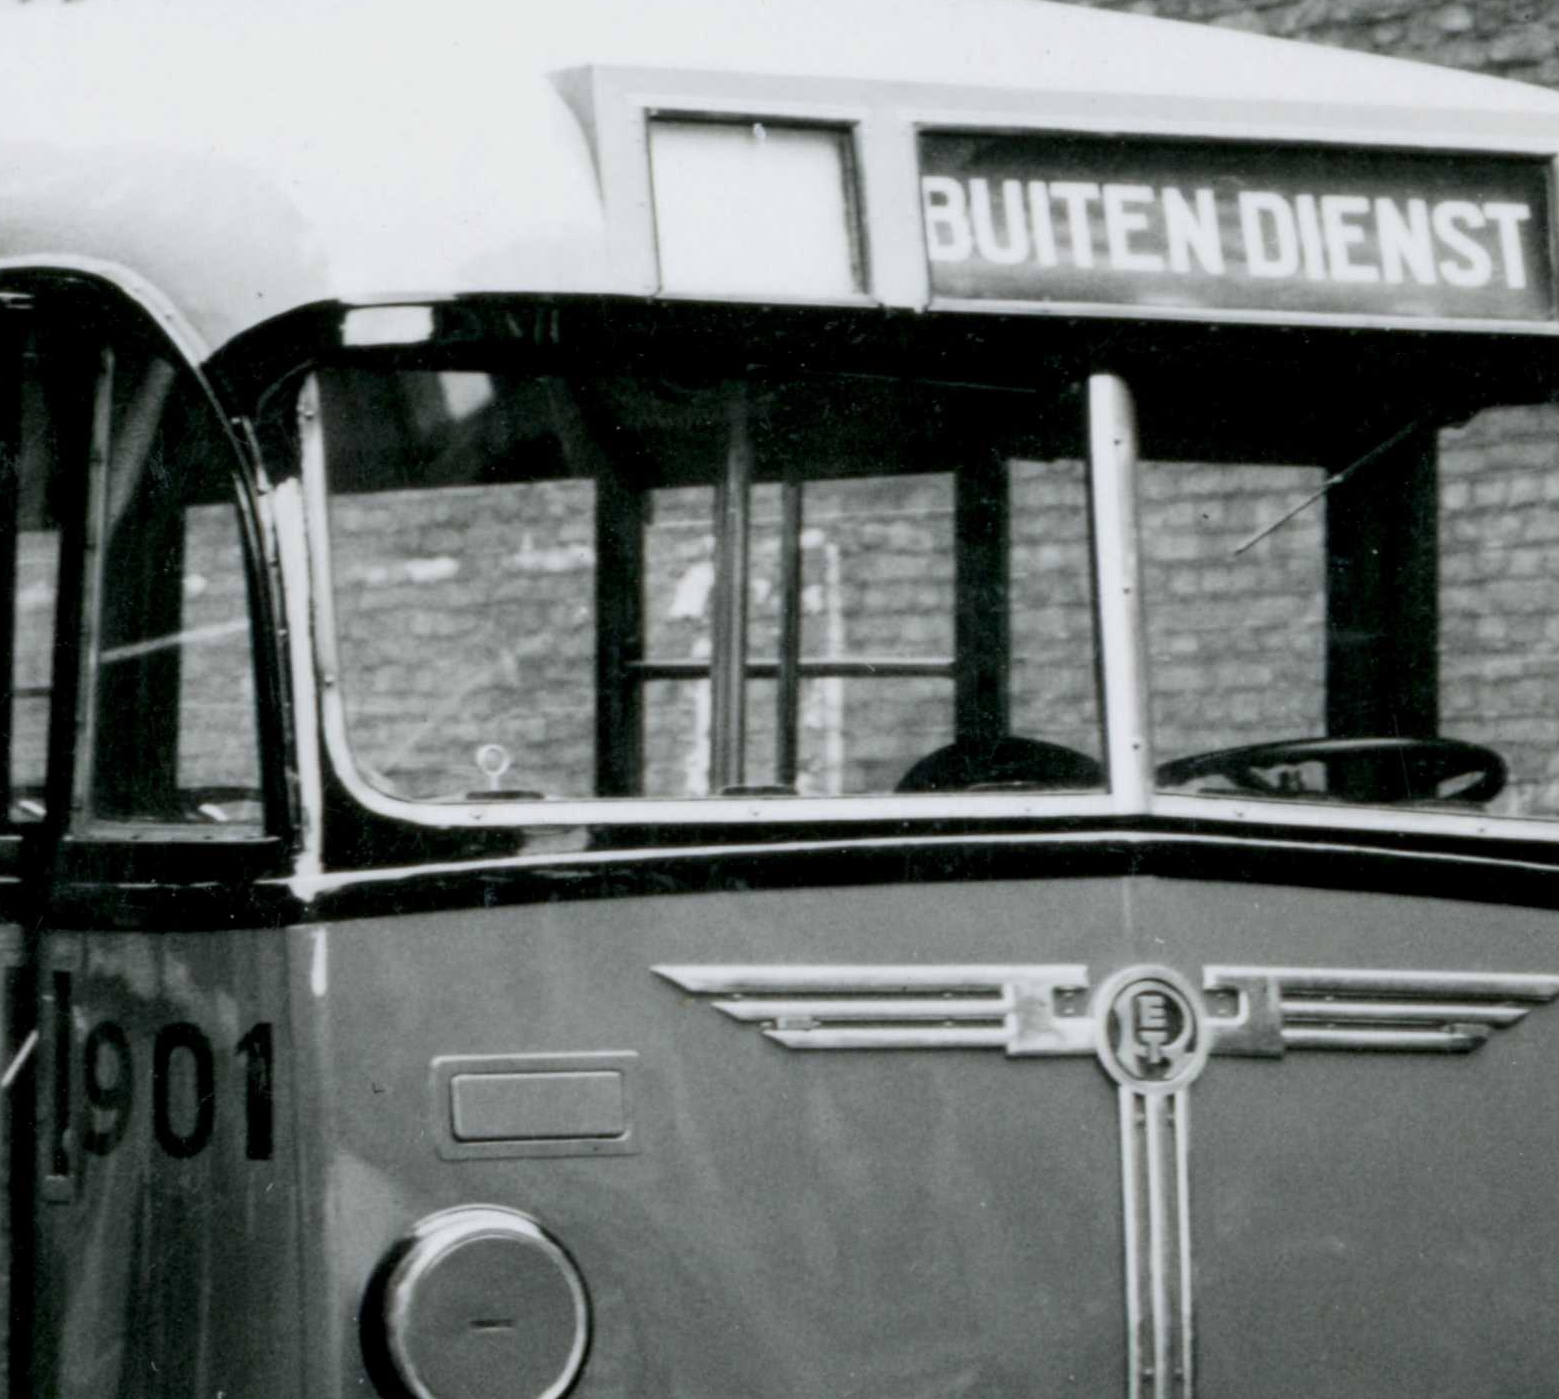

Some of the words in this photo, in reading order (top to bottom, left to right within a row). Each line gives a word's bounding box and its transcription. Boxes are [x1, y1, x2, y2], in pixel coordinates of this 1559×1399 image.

[922, 176, 1225, 276] BUITEN
[1240, 191, 1531, 289] DIENST
[84, 1021, 273, 1161] 901
